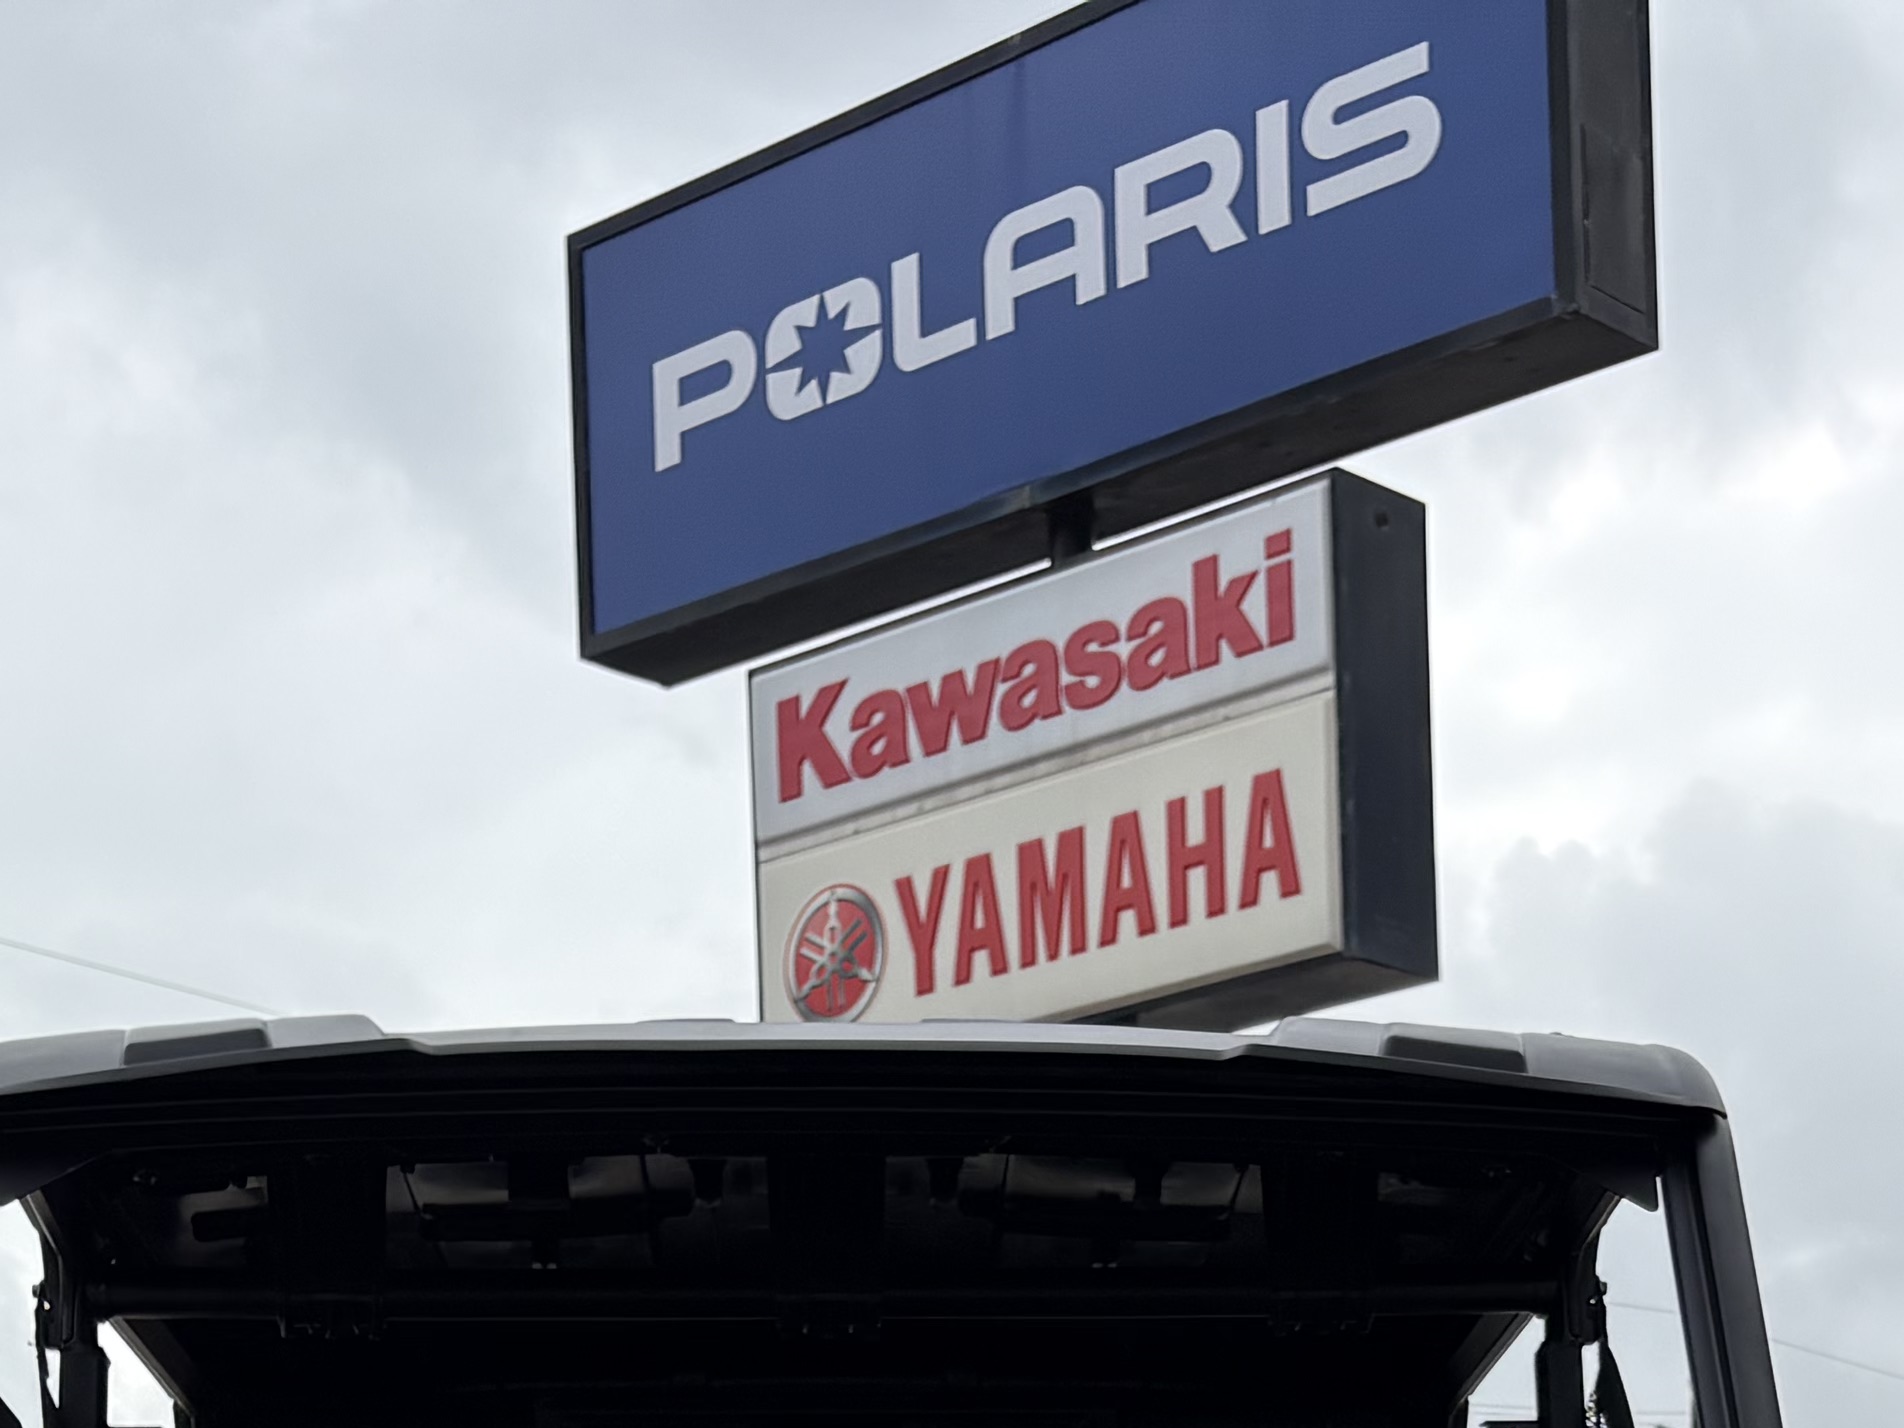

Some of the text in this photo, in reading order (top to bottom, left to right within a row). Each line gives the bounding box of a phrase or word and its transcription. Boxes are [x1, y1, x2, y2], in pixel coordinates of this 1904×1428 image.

[651, 40, 1444, 473] POLARIS
[774, 527, 1295, 804] Kawasaki
[892, 768, 1302, 997] YAMAHA
